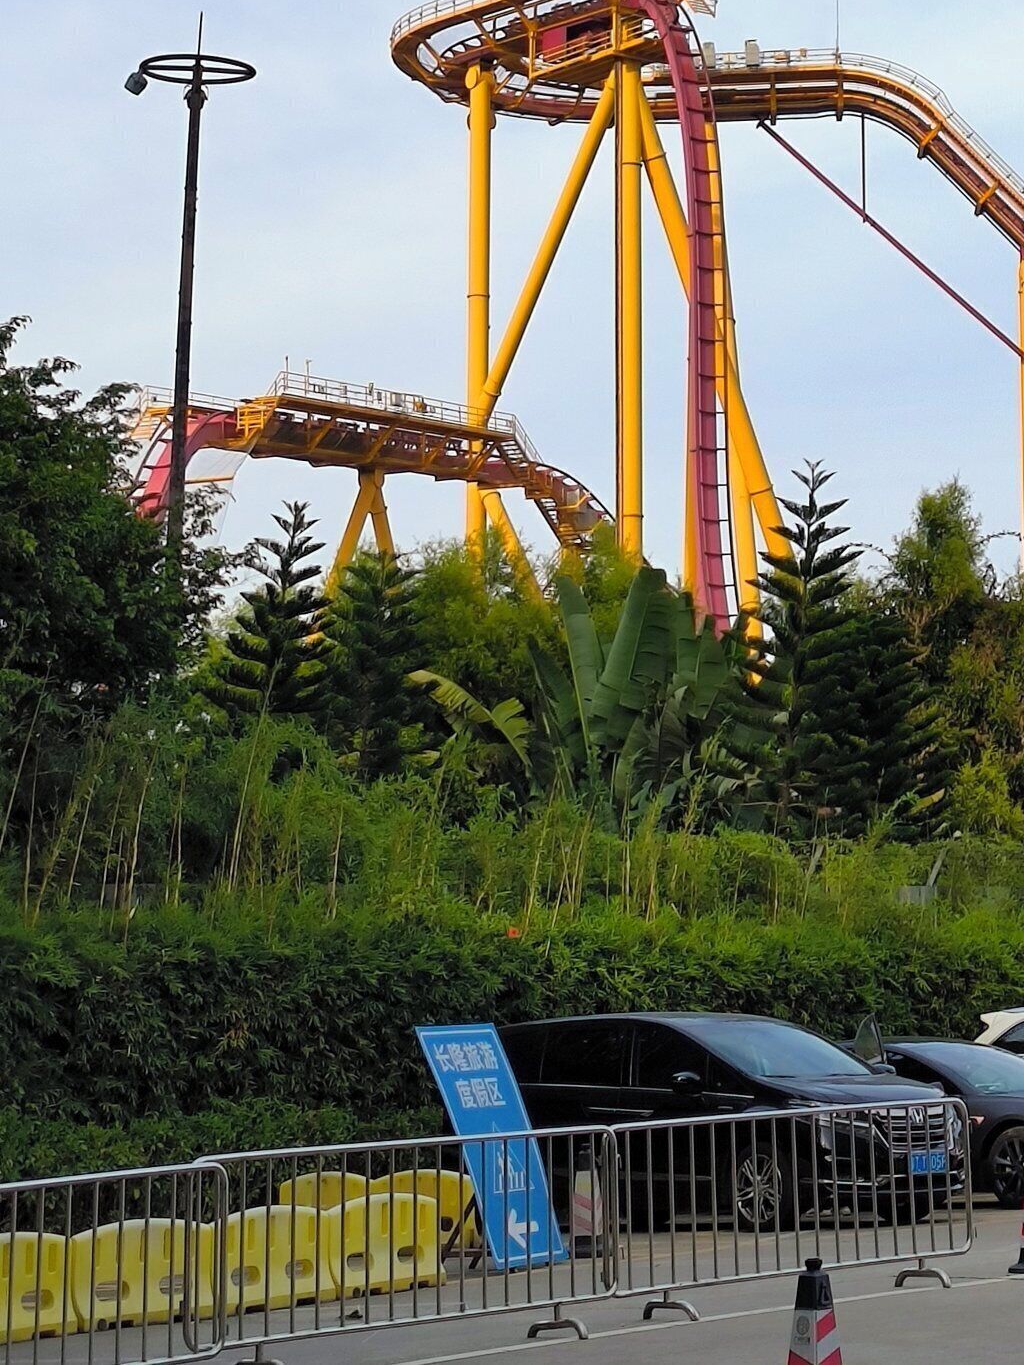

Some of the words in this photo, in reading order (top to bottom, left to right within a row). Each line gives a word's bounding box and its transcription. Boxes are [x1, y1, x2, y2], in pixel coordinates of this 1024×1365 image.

[433, 1042, 498, 1072] 长隆旅游
[455, 1078, 506, 1108] 度假区
